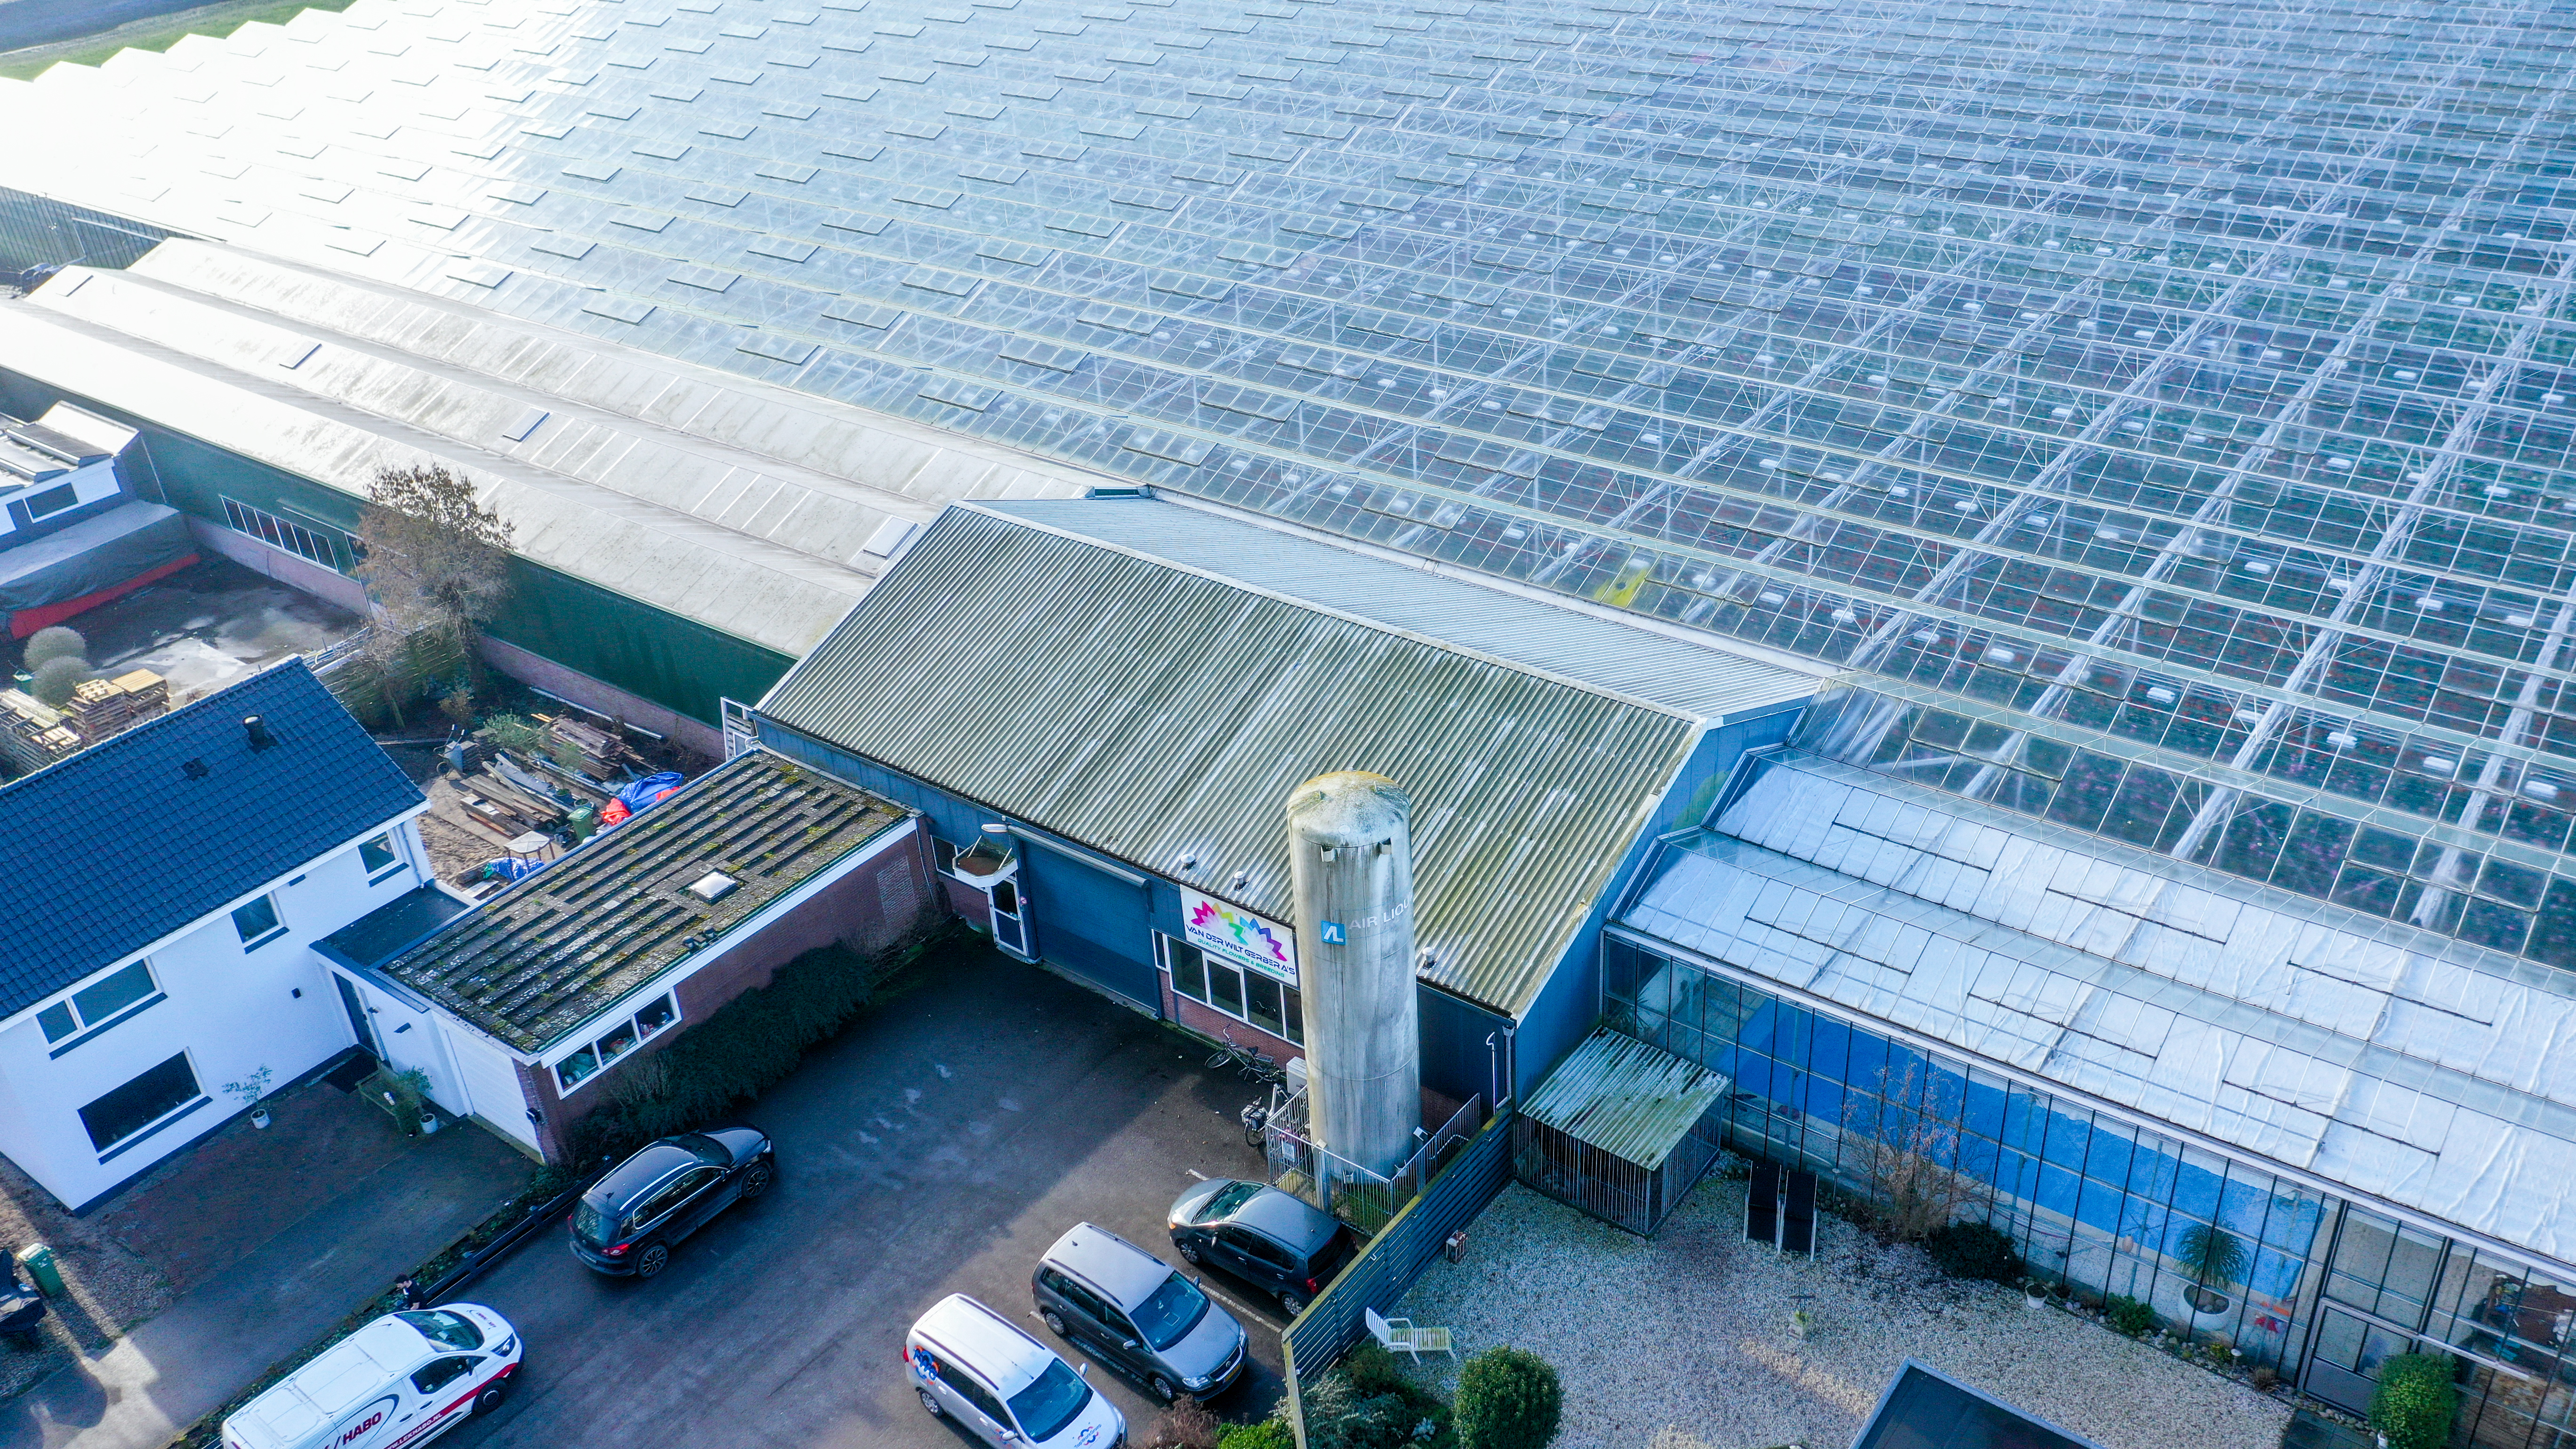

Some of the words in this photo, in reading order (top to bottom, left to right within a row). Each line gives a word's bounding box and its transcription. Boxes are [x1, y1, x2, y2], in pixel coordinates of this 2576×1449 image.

[1348, 916, 1378, 930] AIR
[1185, 924, 1204, 937] VAN
[1206, 933, 1224, 946] DER
[1225, 940, 1244, 953] WILT
[1198, 938, 1221, 950] QUALITY
[1222, 949, 1249, 962] FLOWERS
[1256, 963, 1285, 978] BREEDING
